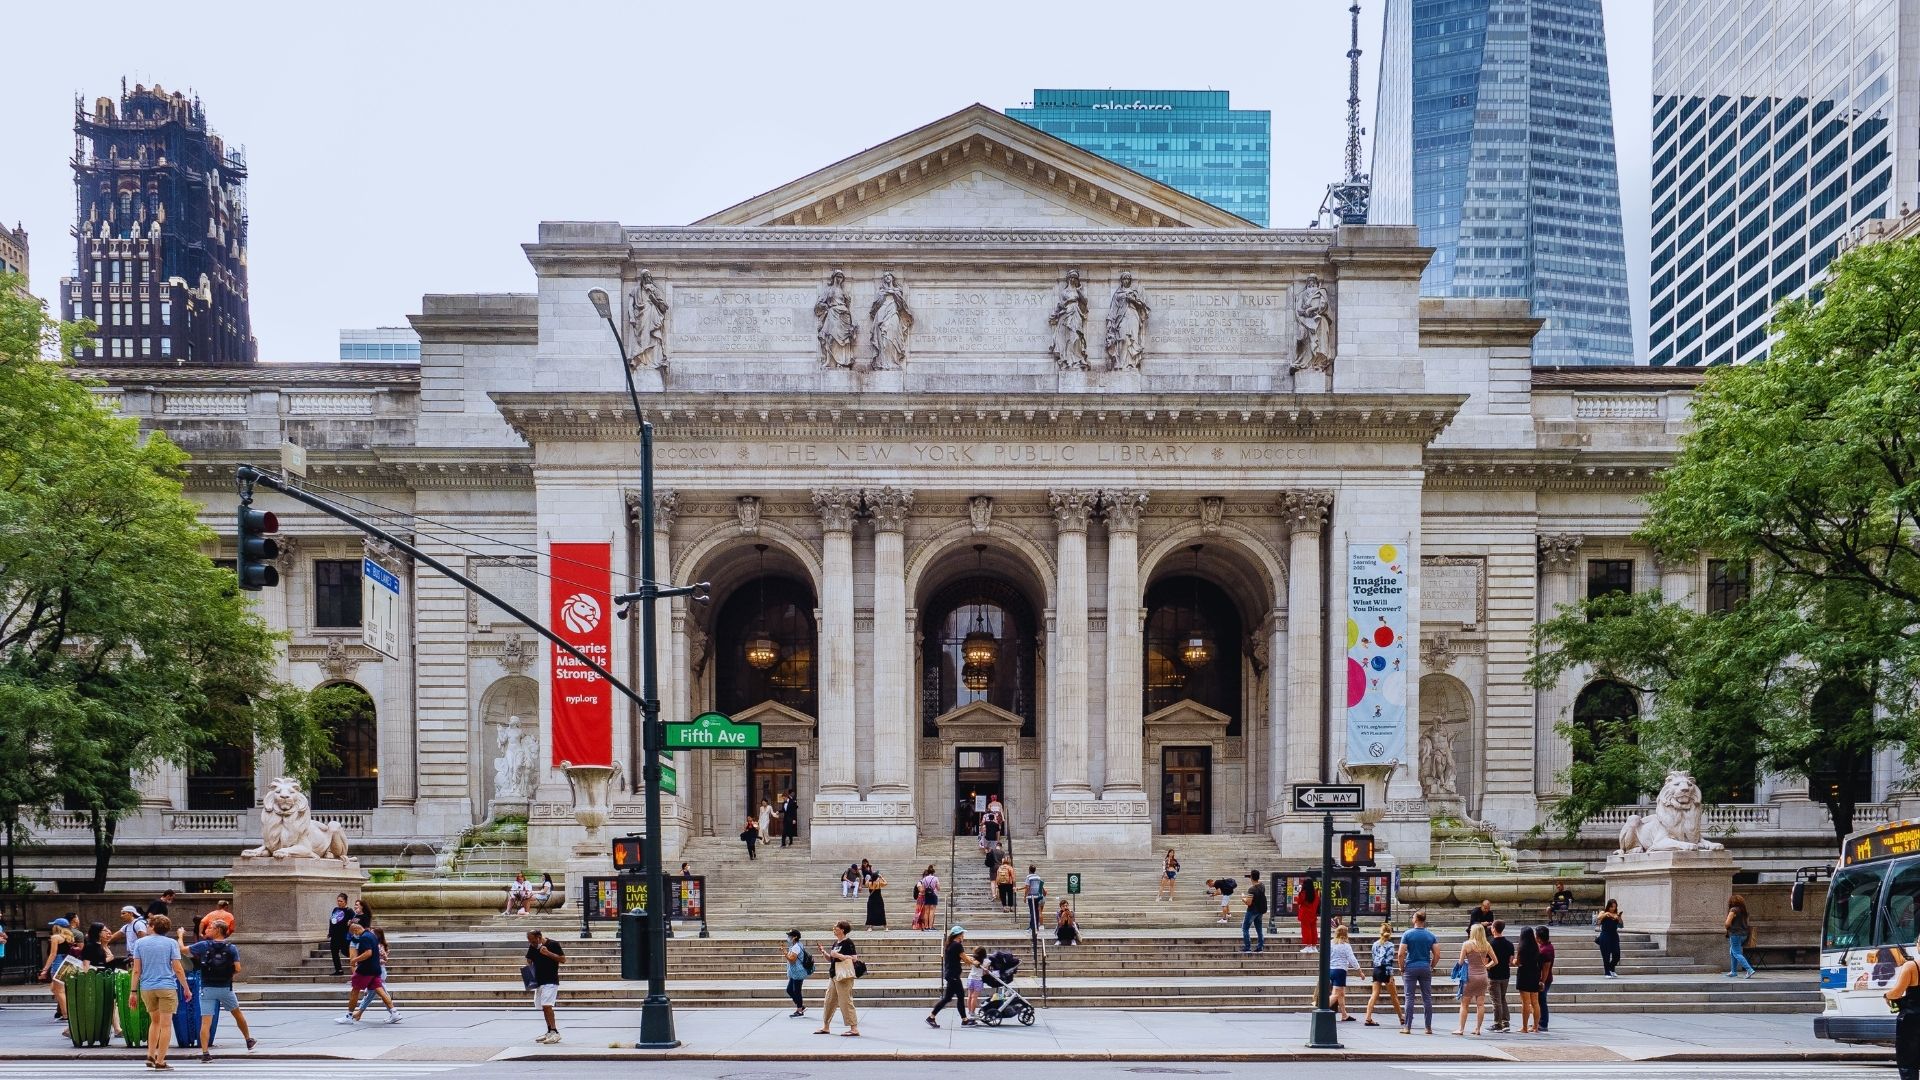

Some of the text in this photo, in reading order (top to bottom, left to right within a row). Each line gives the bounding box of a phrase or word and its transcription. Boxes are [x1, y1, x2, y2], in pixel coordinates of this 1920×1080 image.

[1092, 100, 1173, 110] salesforce
[682, 293, 809, 305] THE ASTOR LIBRARY
[918, 294, 1046, 305] THE LENOX LIBRARY
[1152, 295, 1279, 306] THE TILDEN TRUST
[727, 317, 758, 326] JACOB
[764, 317, 793, 326] ASTOR
[945, 318, 1017, 327] JAMES LENOX
[633, 447, 720, 459] MCCCXCV
[769, 445, 818, 461] THE
[836, 445, 894, 461] NEW
[914, 445, 975, 461] YORK
[994, 445, 1075, 461] PUBLIC
[1098, 445, 1194, 461] LIBRARY
[381, 572, 392, 587] LANES
[1353, 576, 1397, 587] Imagine
[1353, 586, 1402, 597] Together
[556, 643, 607, 654] Laries
[592, 656, 607, 667] Us
[556, 669, 604, 682] Stronge
[566, 695, 598, 705] nypl.org
[680, 729, 746, 743] Fifth Ave
[1306, 793, 1352, 802] ONE WAY
[1857, 838, 1871, 860] M4
[1904, 841, 1910, 852] 5
[626, 885, 648, 893] BLAC
[1313, 881, 1341, 889] BLCK
[626, 902, 647, 911] MAT
